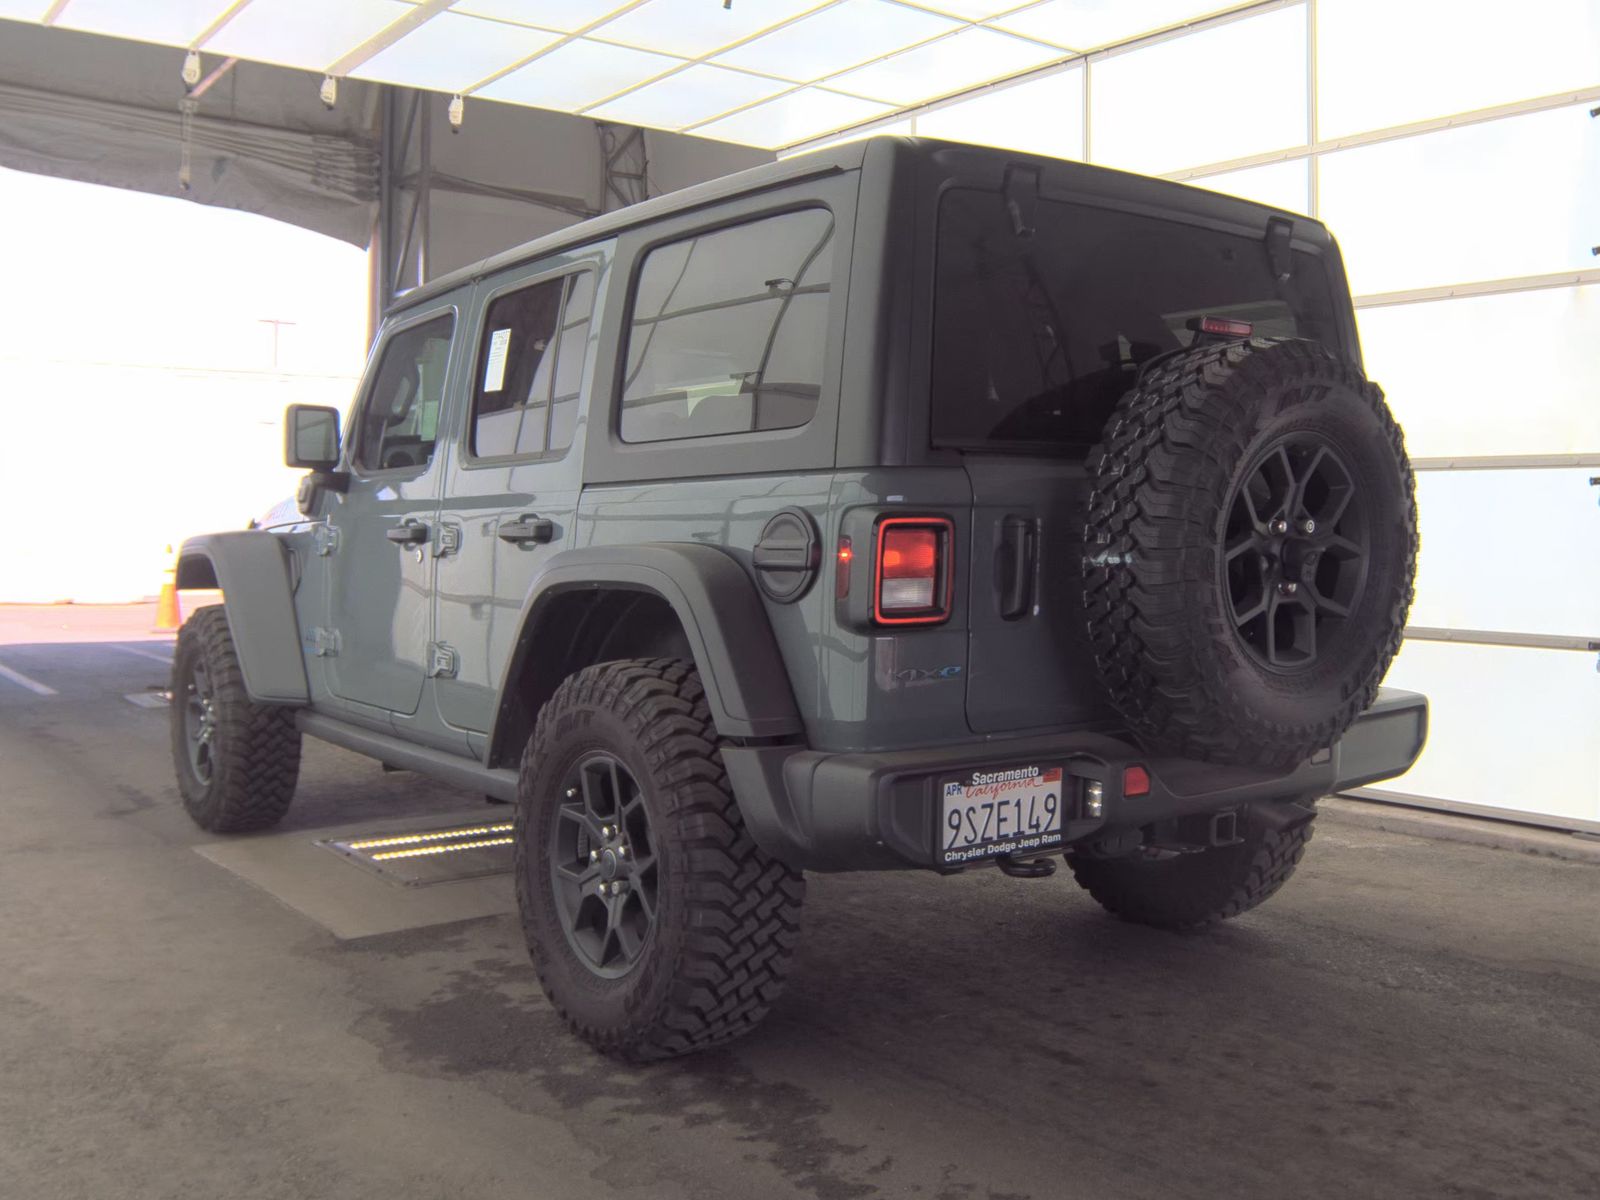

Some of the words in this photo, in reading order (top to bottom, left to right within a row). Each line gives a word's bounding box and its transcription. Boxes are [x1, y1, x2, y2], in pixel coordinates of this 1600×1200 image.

[972, 766, 1039, 785] Sacramento
[946, 785, 962, 796] APR
[965, 777, 1043, 799] California
[947, 793, 1057, 849] 9SZE149
[944, 847, 985, 862] Chrysler
[987, 842, 1016, 854] Dodge
[1019, 838, 1040, 848] Jeep
[1041, 833, 1061, 845] Ram
